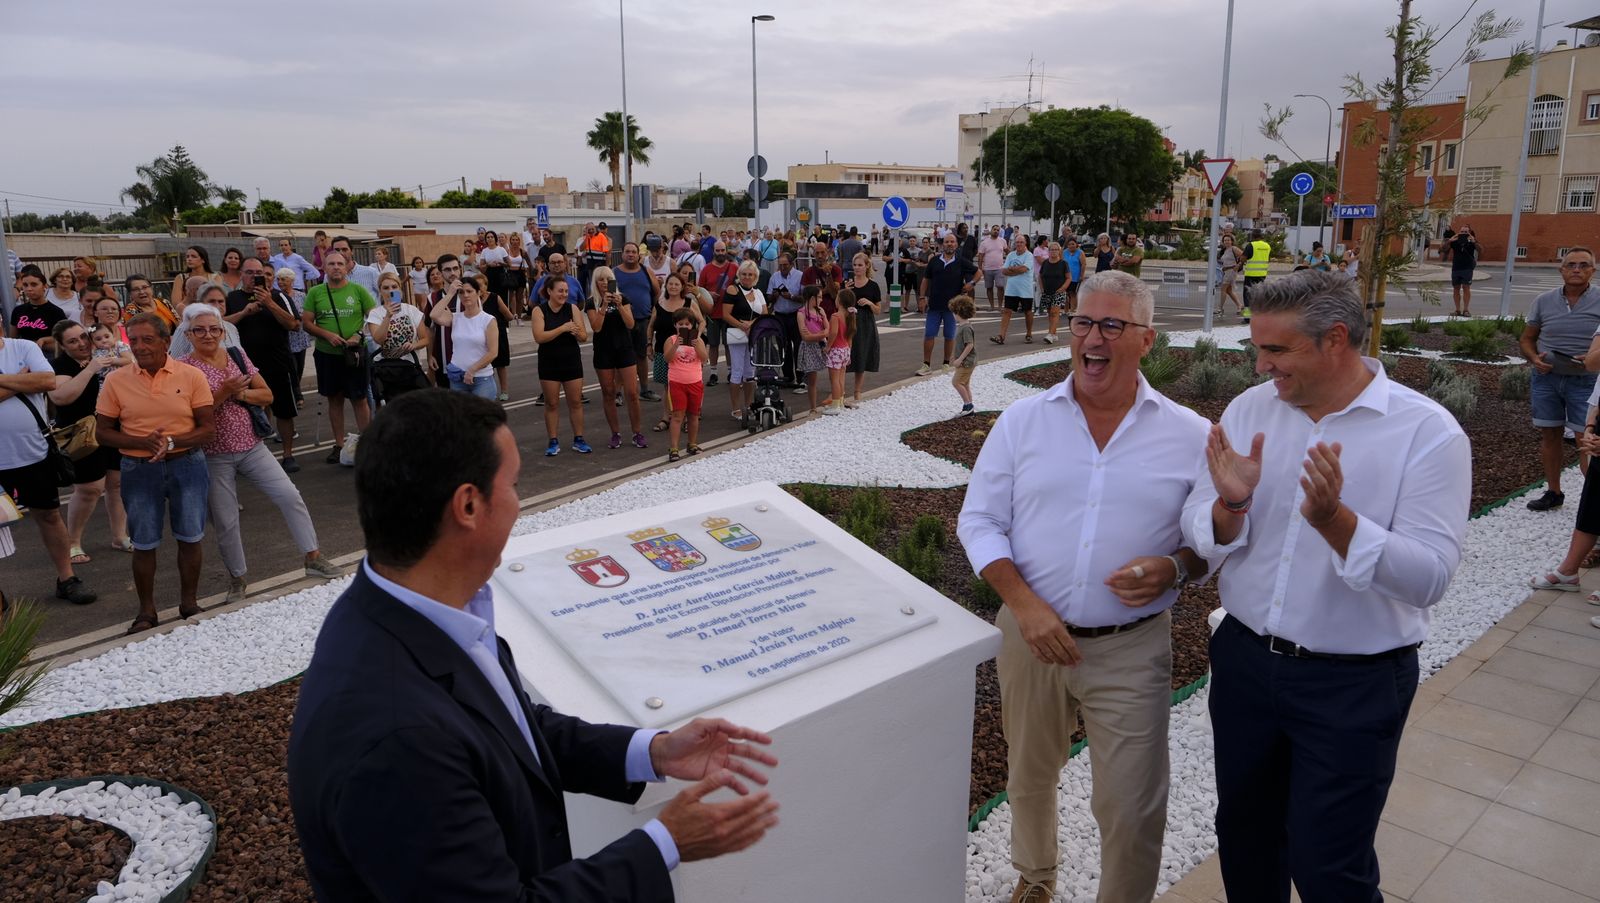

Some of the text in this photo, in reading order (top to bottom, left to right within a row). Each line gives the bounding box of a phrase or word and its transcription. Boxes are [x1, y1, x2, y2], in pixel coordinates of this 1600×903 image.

[1341, 207, 1366, 216] FANY
[17, 315, 48, 330] Barbie
[550, 606, 575, 617] Este
[576, 597, 610, 610] Puente
[611, 592, 630, 602] que
[630, 586, 647, 597] une
[649, 582, 662, 592] los
[663, 570, 707, 588] municipios
[708, 566, 719, 574] de
[761, 548, 790, 558] Almería
[794, 541, 816, 549] Viator
[619, 598, 636, 606] fue
[637, 584, 686, 602] inaugurado
[685, 580, 703, 588] tras
[715, 562, 768, 578] remodelación
[635, 569, 798, 620] D. Javier Aureliano García Molina
[602, 621, 654, 640] Presidente
[656, 616, 668, 624] de
[678, 604, 712, 616] Excma.
[711, 590, 757, 608] Diputación
[756, 578, 794, 594] Provincial
[666, 626, 697, 638] siendo
[697, 616, 729, 629] alcalde
[729, 612, 741, 620] de
[774, 598, 786, 606] de
[786, 589, 816, 602] Almería
[697, 602, 807, 640] D. Ismael Torres Miras
[701, 616, 856, 674] D. Manuel Jesús Flores Malpica
[758, 634, 770, 643] de
[768, 626, 796, 638] Viator
[748, 636, 850, 678] 6 de septiembre de 2023
